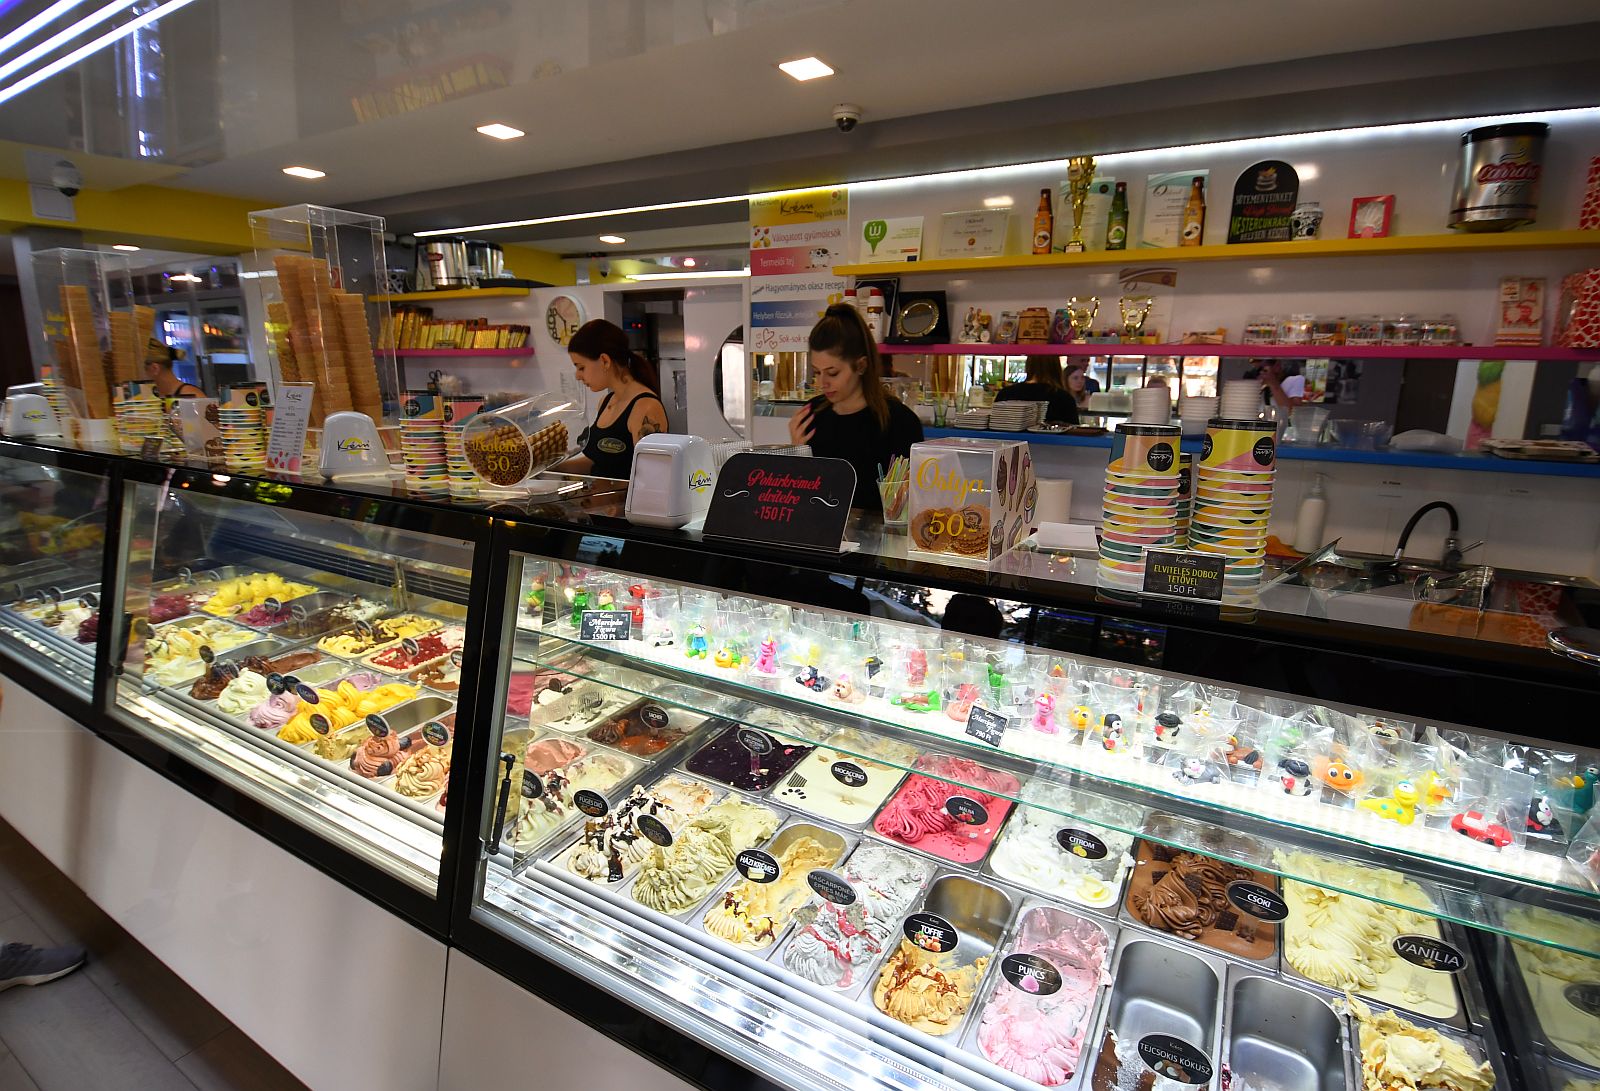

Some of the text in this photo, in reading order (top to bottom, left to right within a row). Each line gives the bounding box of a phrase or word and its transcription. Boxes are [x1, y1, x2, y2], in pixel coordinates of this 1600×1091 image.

[772, 228, 841, 242] Válogatott gyümölcsök
[765, 282, 807, 293] Hagyományos
[808, 282, 824, 290] olasz
[747, 469, 822, 491] Pohárkrémek
[917, 457, 985, 507] Ostya
[758, 489, 801, 505] elvitelre
[779, 508, 794, 523] FT
[1153, 564, 1218, 580] ELVITELES DOBOZ
[1167, 573, 1199, 586] TETŐVEL
[1167, 584, 1197, 596] 150 Ft
[1068, 836, 1096, 850] CITROM
[740, 854, 777, 875] HÁZI KRÉMES
[813, 881, 834, 894] EPRES
[1247, 893, 1271, 908] CSOKI
[1396, 939, 1460, 967] VANÍLIA
[1018, 964, 1046, 980] PUNCS
[1139, 1042, 1178, 1063] TEJCSOKIS
[1179, 1057, 1211, 1075] KÓKUSZ
